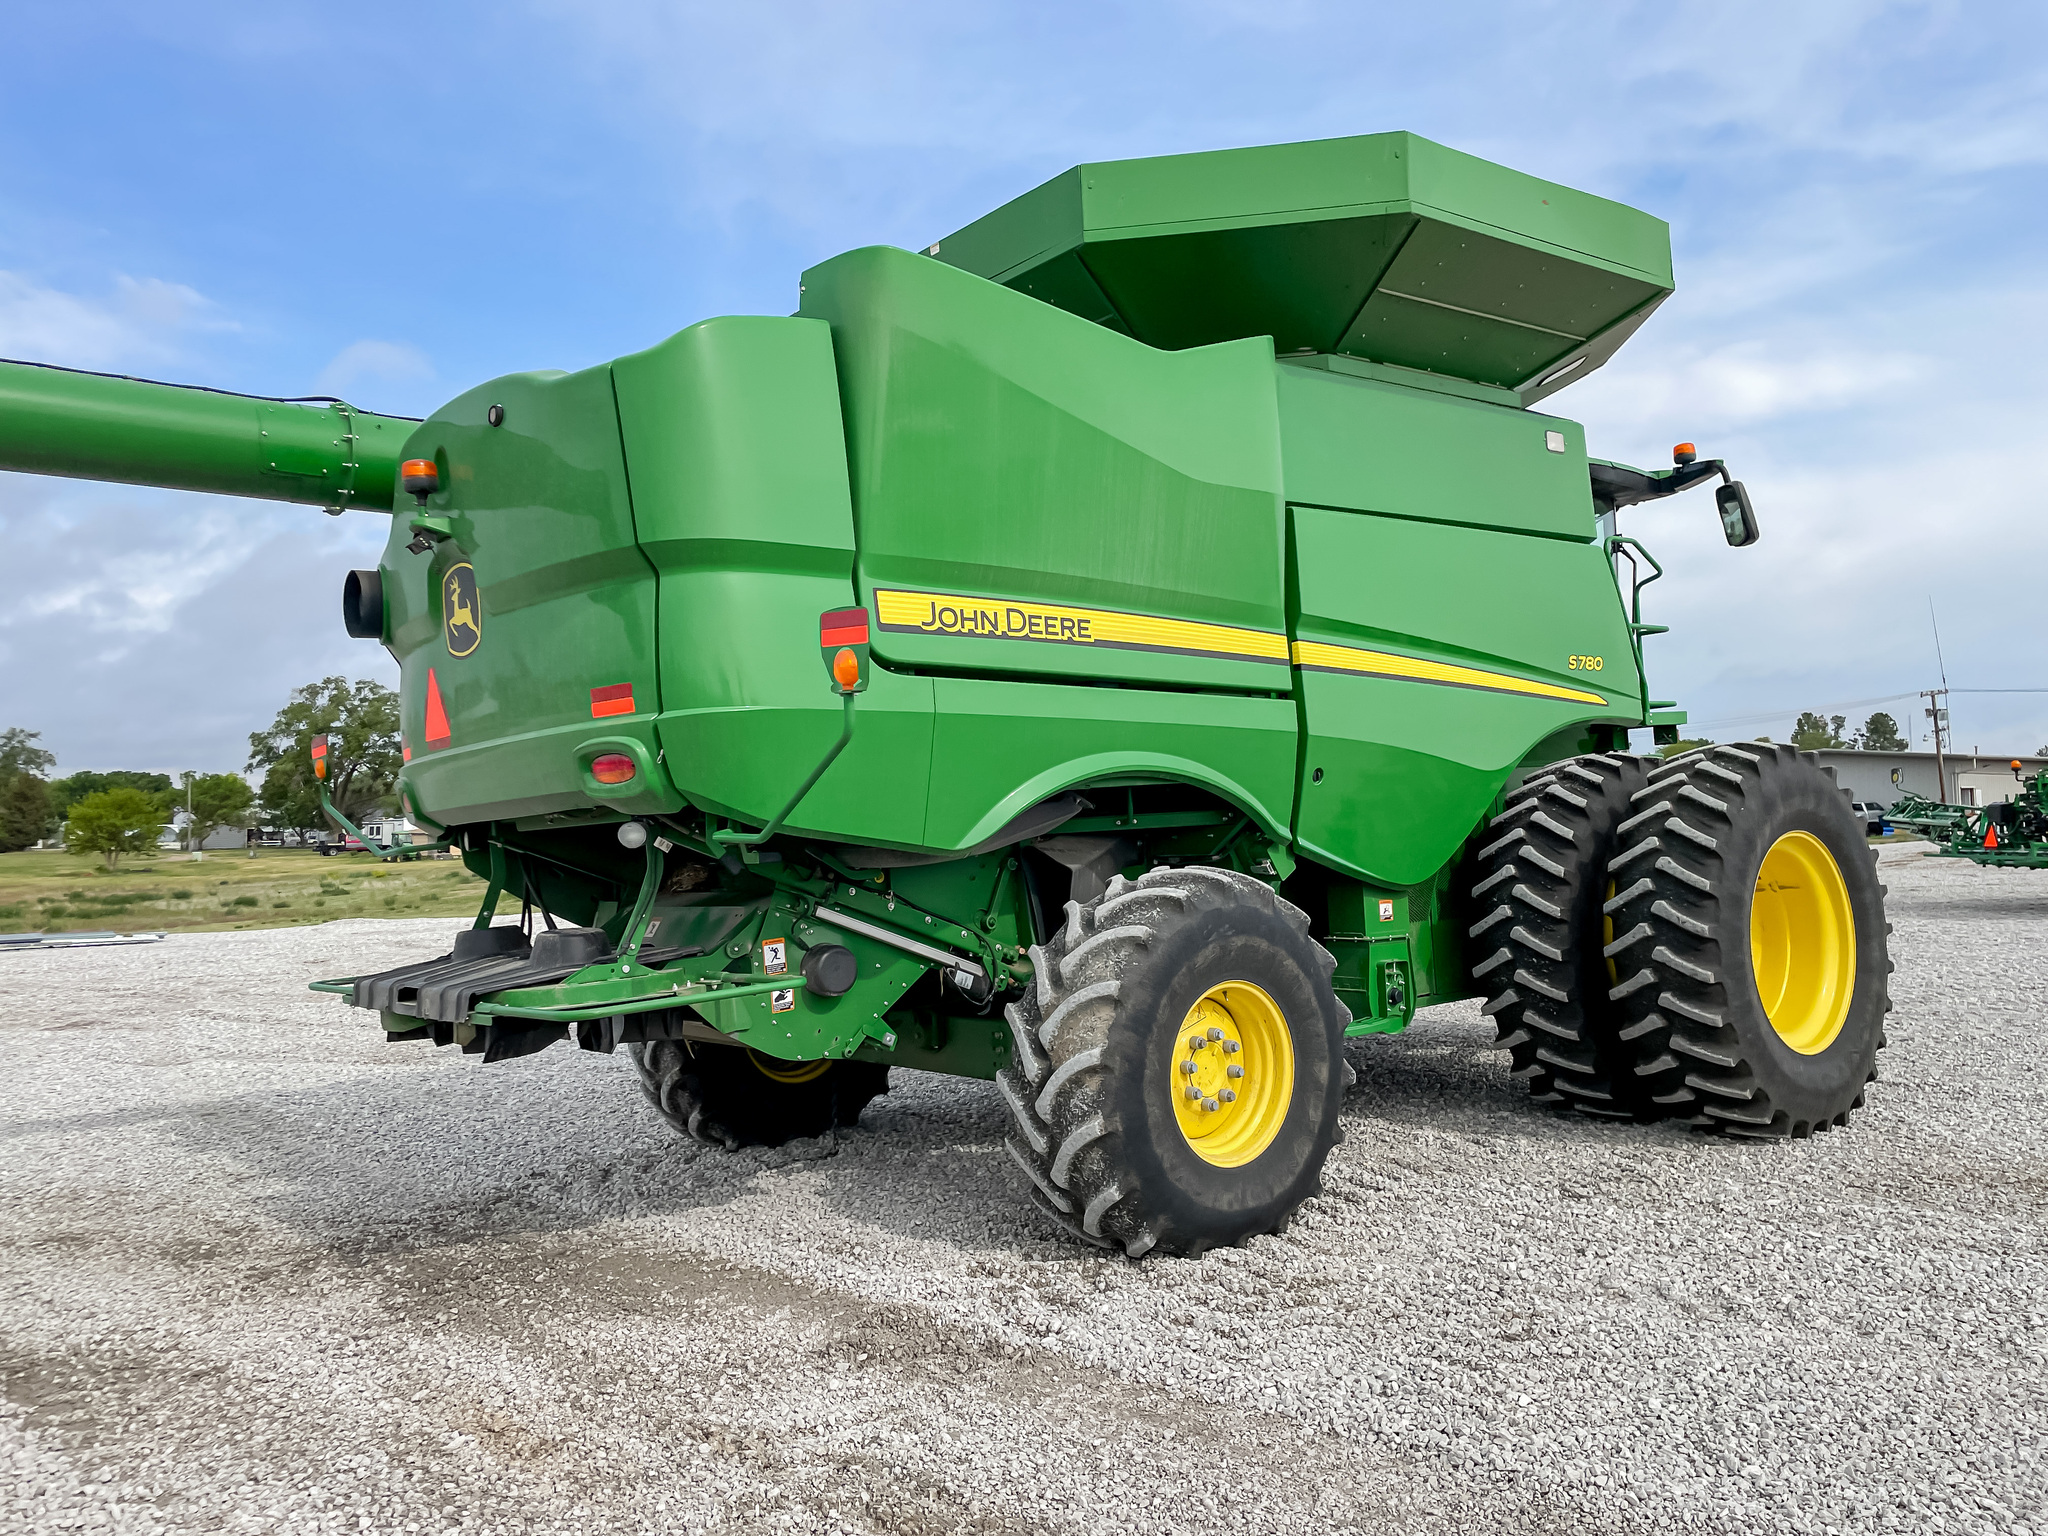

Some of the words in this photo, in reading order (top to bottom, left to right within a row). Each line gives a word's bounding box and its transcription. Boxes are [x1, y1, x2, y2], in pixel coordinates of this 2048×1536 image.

[921, 601, 999, 632] JOHN
[1006, 607, 1092, 639] DEERE
[1568, 654, 1604, 671] S780
